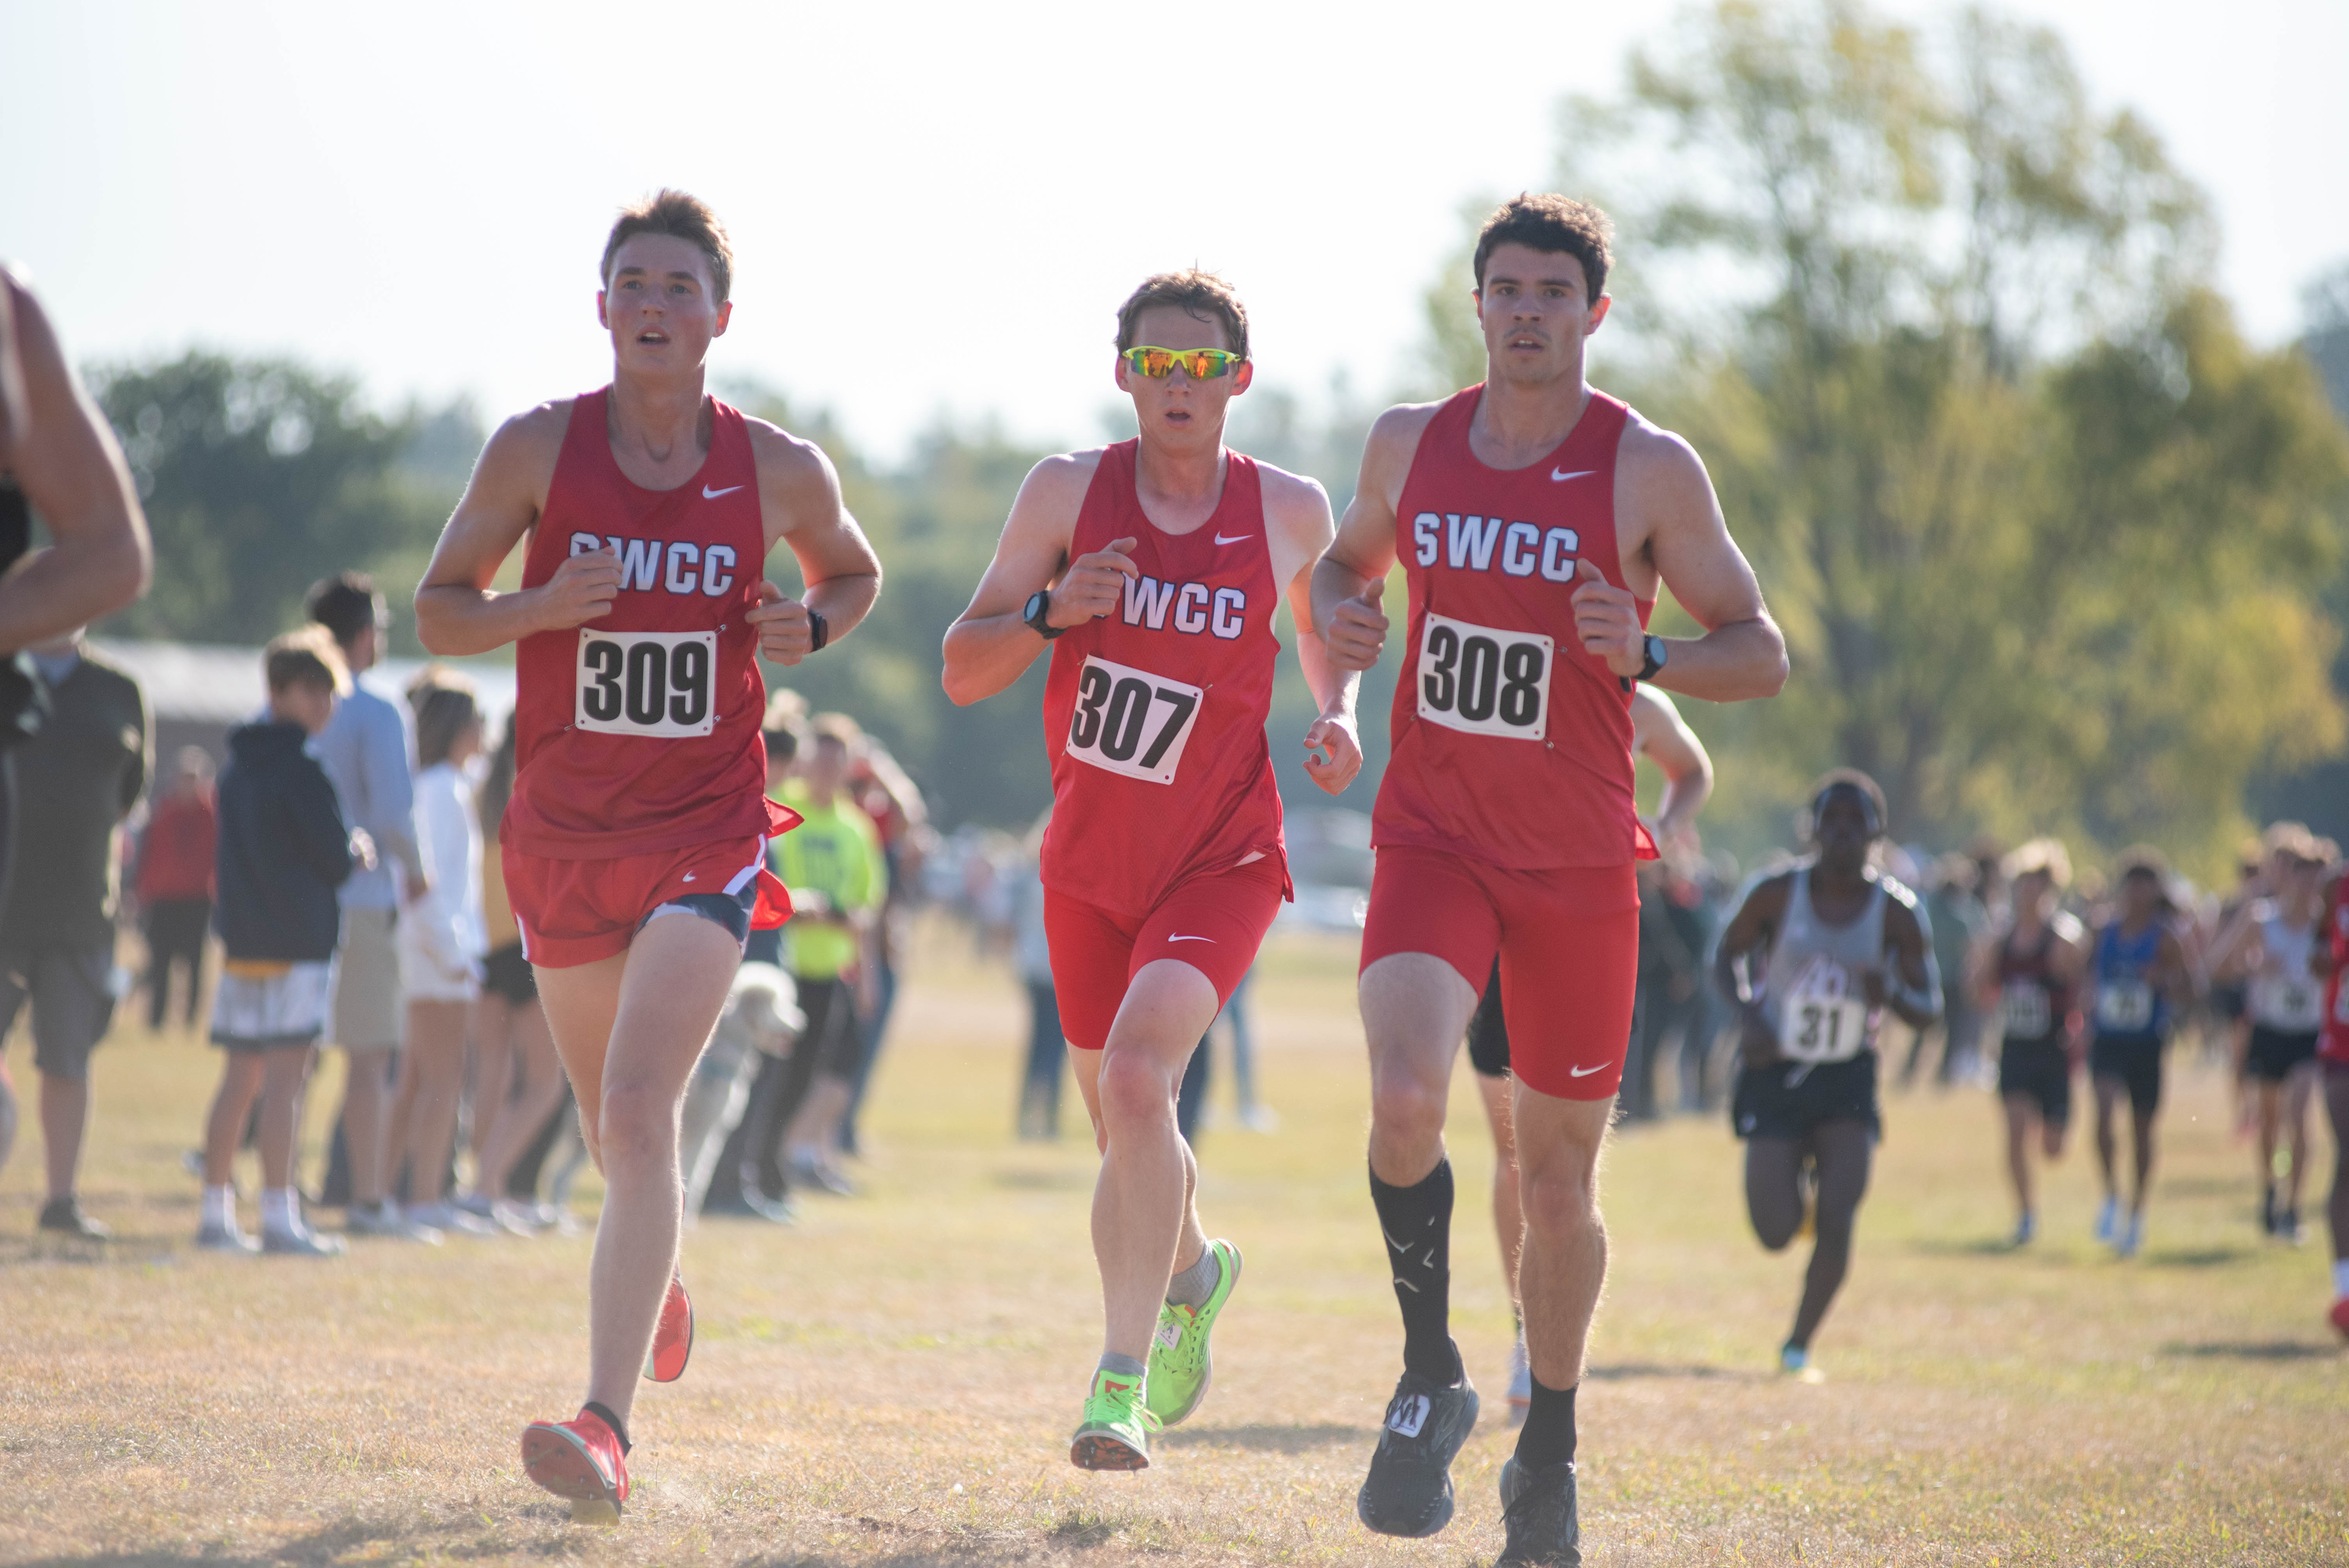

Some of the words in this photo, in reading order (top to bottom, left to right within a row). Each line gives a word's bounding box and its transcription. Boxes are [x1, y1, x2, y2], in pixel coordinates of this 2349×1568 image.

[1414, 511, 1579, 584] SWCC
[1094, 573, 1246, 640] WCC
[583, 640, 709, 726] 309
[1424, 624, 1545, 727] 308
[1071, 665, 1197, 770] 307
[1798, 1005, 1840, 1049] 31
